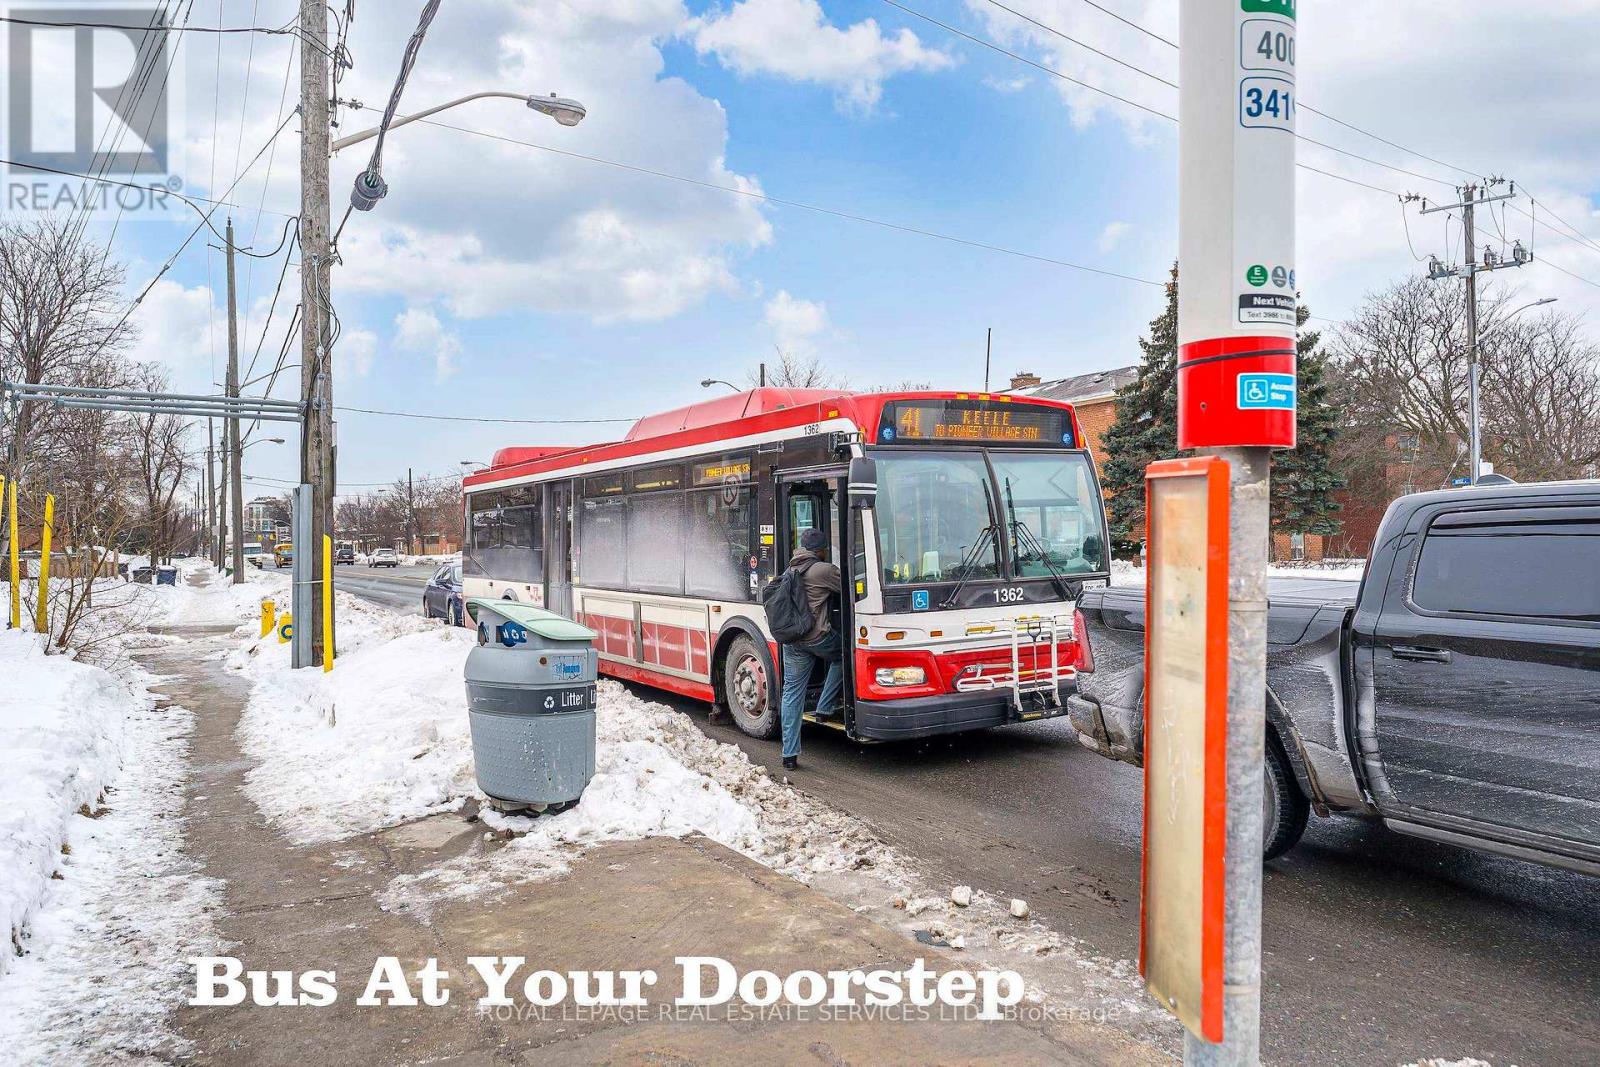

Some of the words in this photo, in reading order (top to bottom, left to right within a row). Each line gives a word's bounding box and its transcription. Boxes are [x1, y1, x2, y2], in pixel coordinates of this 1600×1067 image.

[1246, 87, 1296, 121] 341
[1253, 296, 1275, 305] Next
[901, 407, 921, 437] 41
[963, 409, 1011, 426] KEELE
[804, 424, 820, 436] 1362
[993, 587, 1024, 603] 1362
[561, 691, 584, 707] Litter
